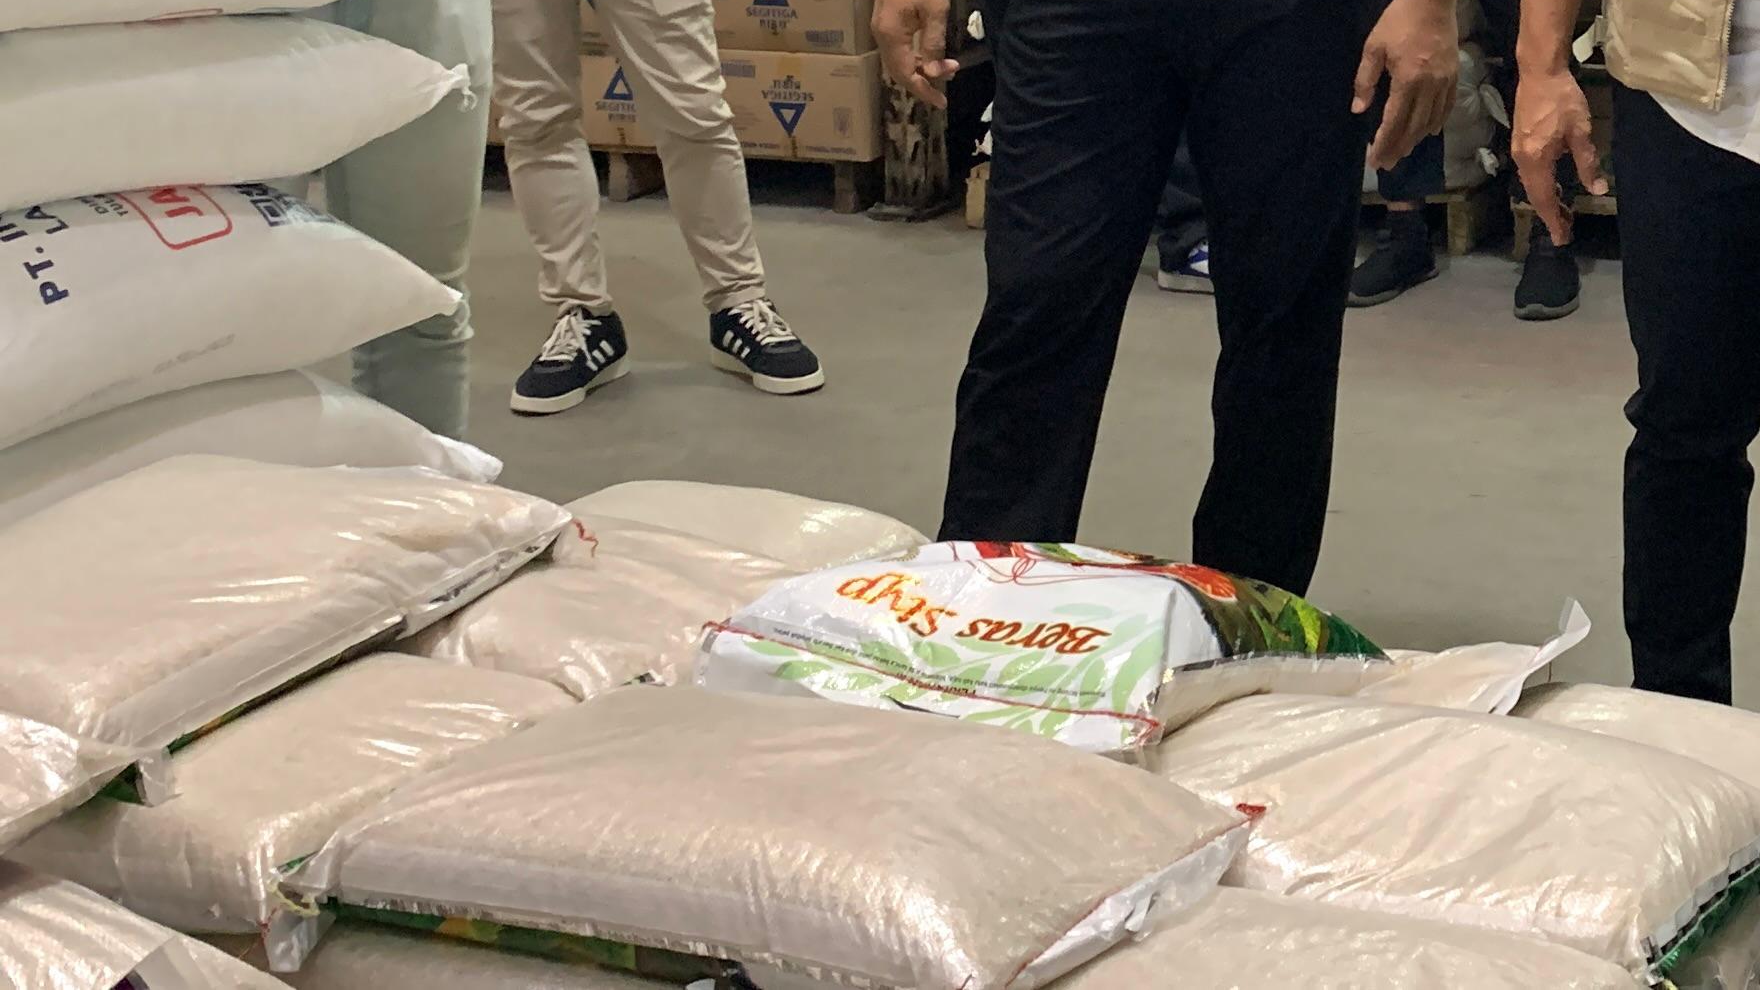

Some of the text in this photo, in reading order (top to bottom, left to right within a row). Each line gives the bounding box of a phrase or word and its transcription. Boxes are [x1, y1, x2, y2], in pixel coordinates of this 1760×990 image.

[745, 6, 798, 19] SEGITIGA
[762, 88, 814, 102] SEGITIGA
[23, 244, 69, 306] PT.
[954, 617, 1112, 655] Beras
